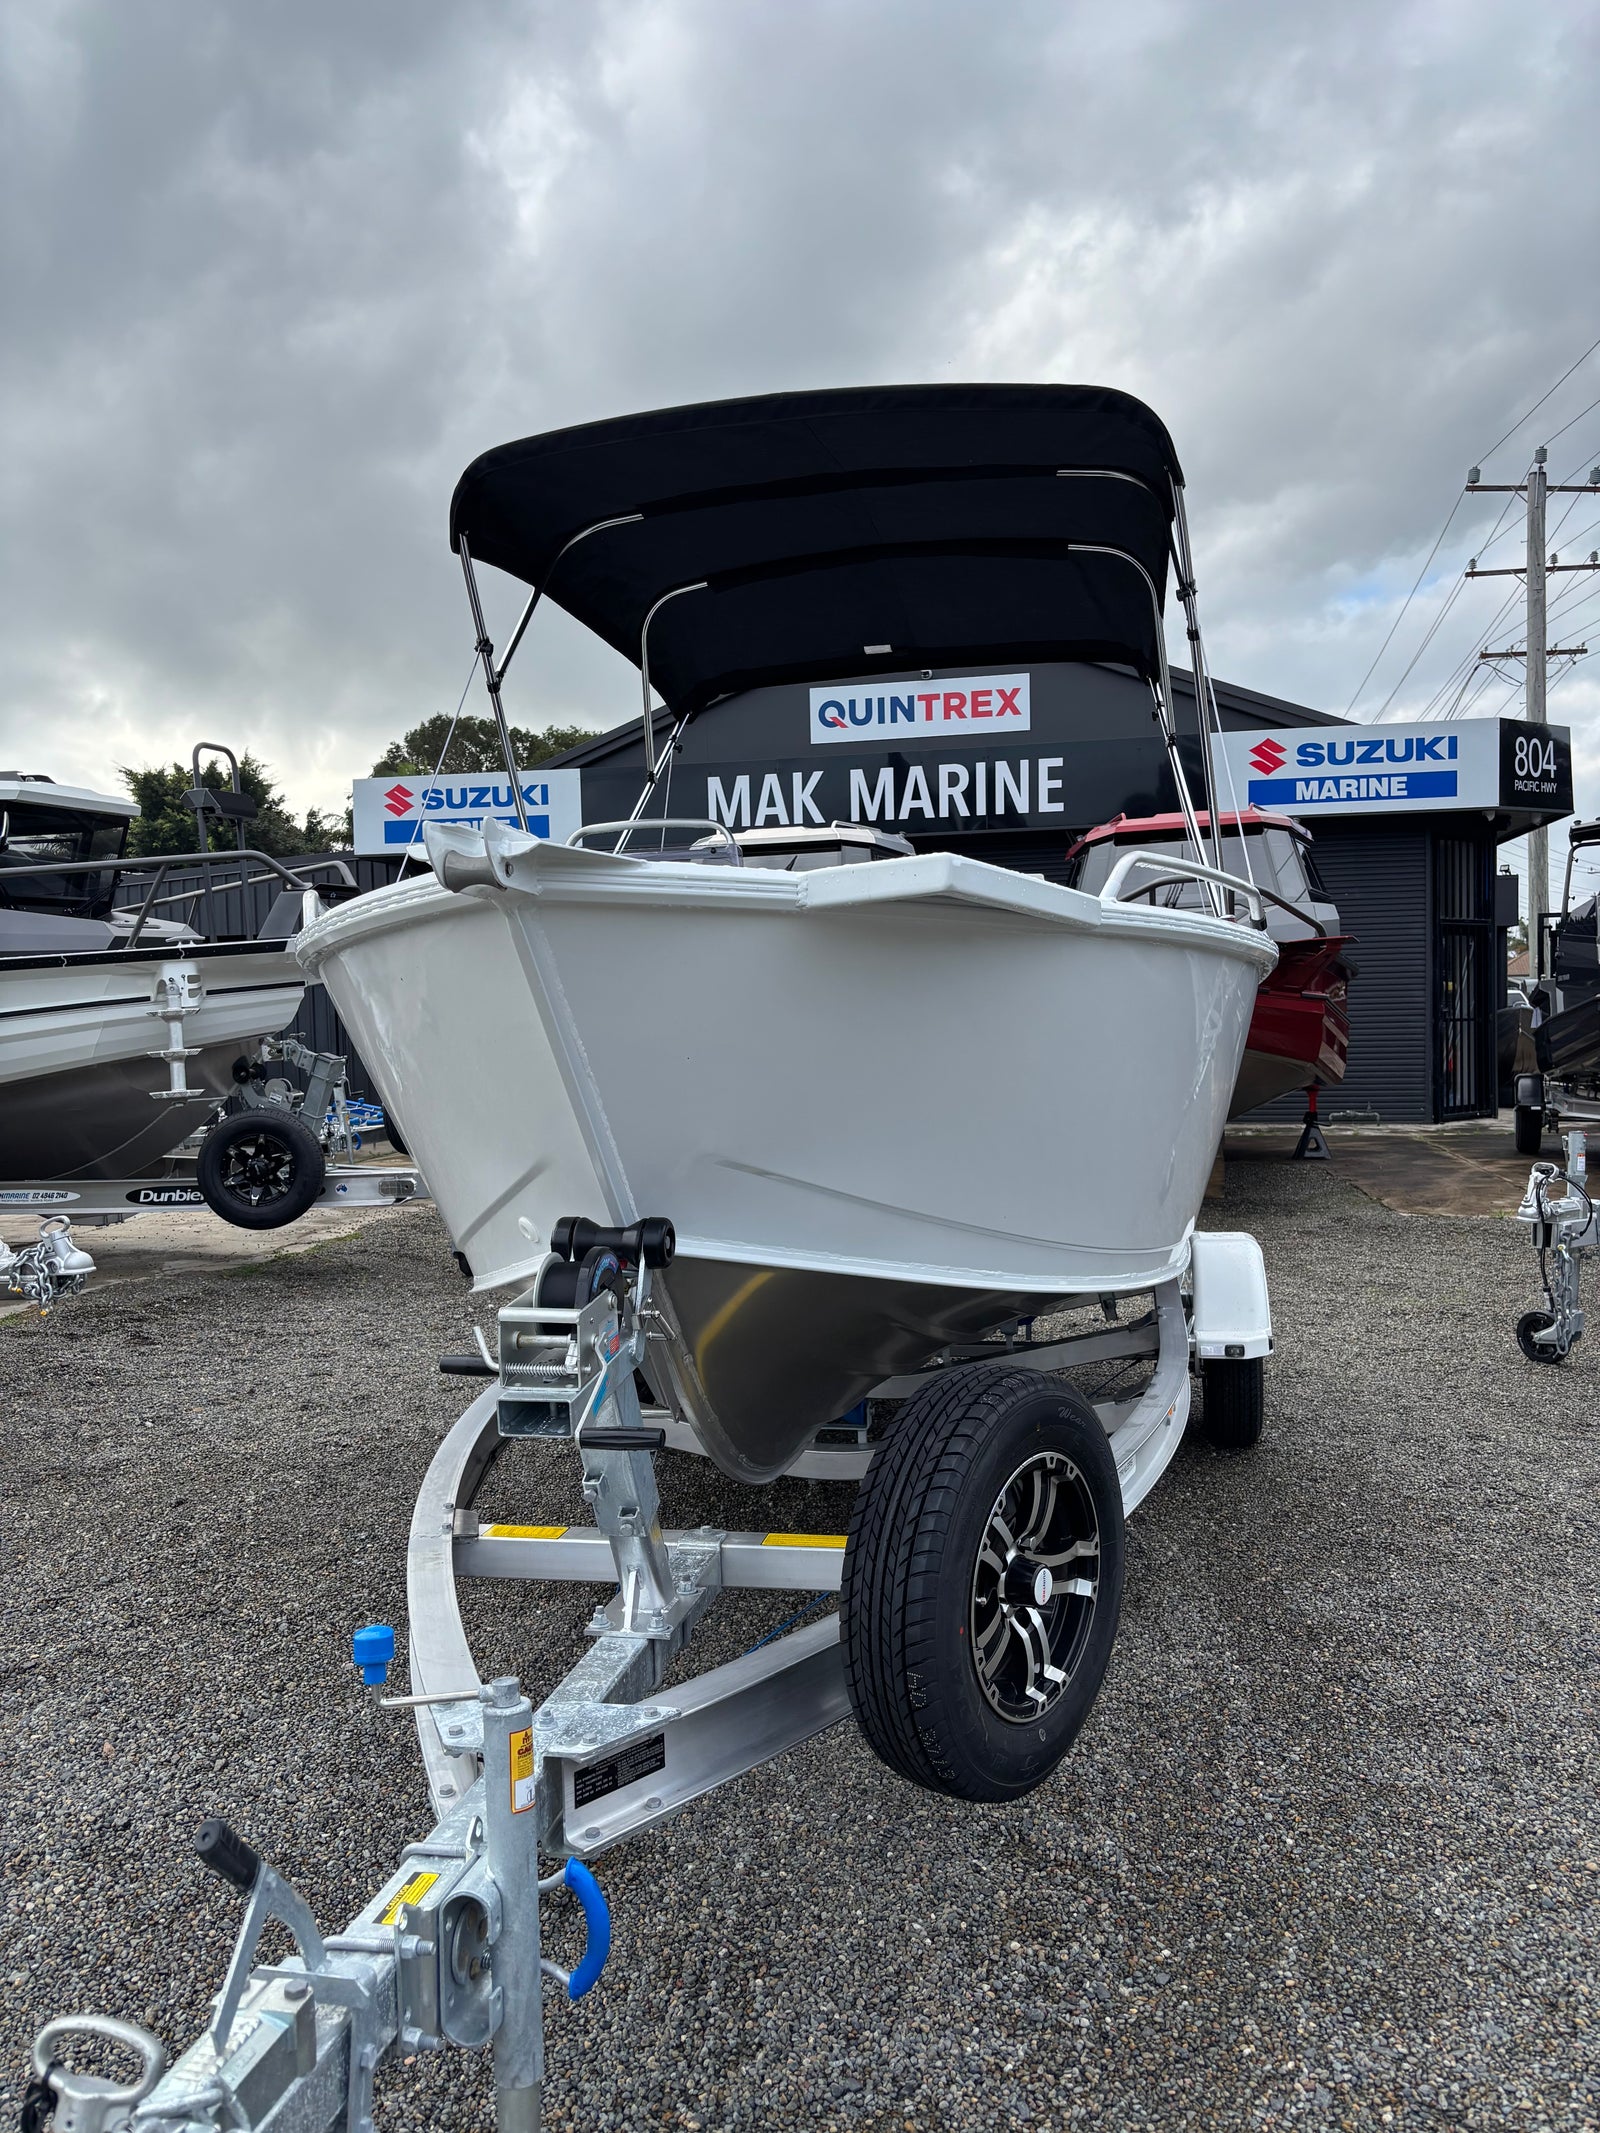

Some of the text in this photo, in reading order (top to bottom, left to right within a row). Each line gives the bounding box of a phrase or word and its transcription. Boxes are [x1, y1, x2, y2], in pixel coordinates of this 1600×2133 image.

[817, 687, 1022, 729] QUINTREX
[1296, 735, 1458, 767] SUZUKI
[1514, 736, 1557, 779] 804
[421, 783, 549, 810] SUZUKI
[707, 757, 1065, 828] MAK MARINE
[1296, 776, 1408, 802] MARINE
[1514, 779, 1558, 793] PACIFIC HWY
